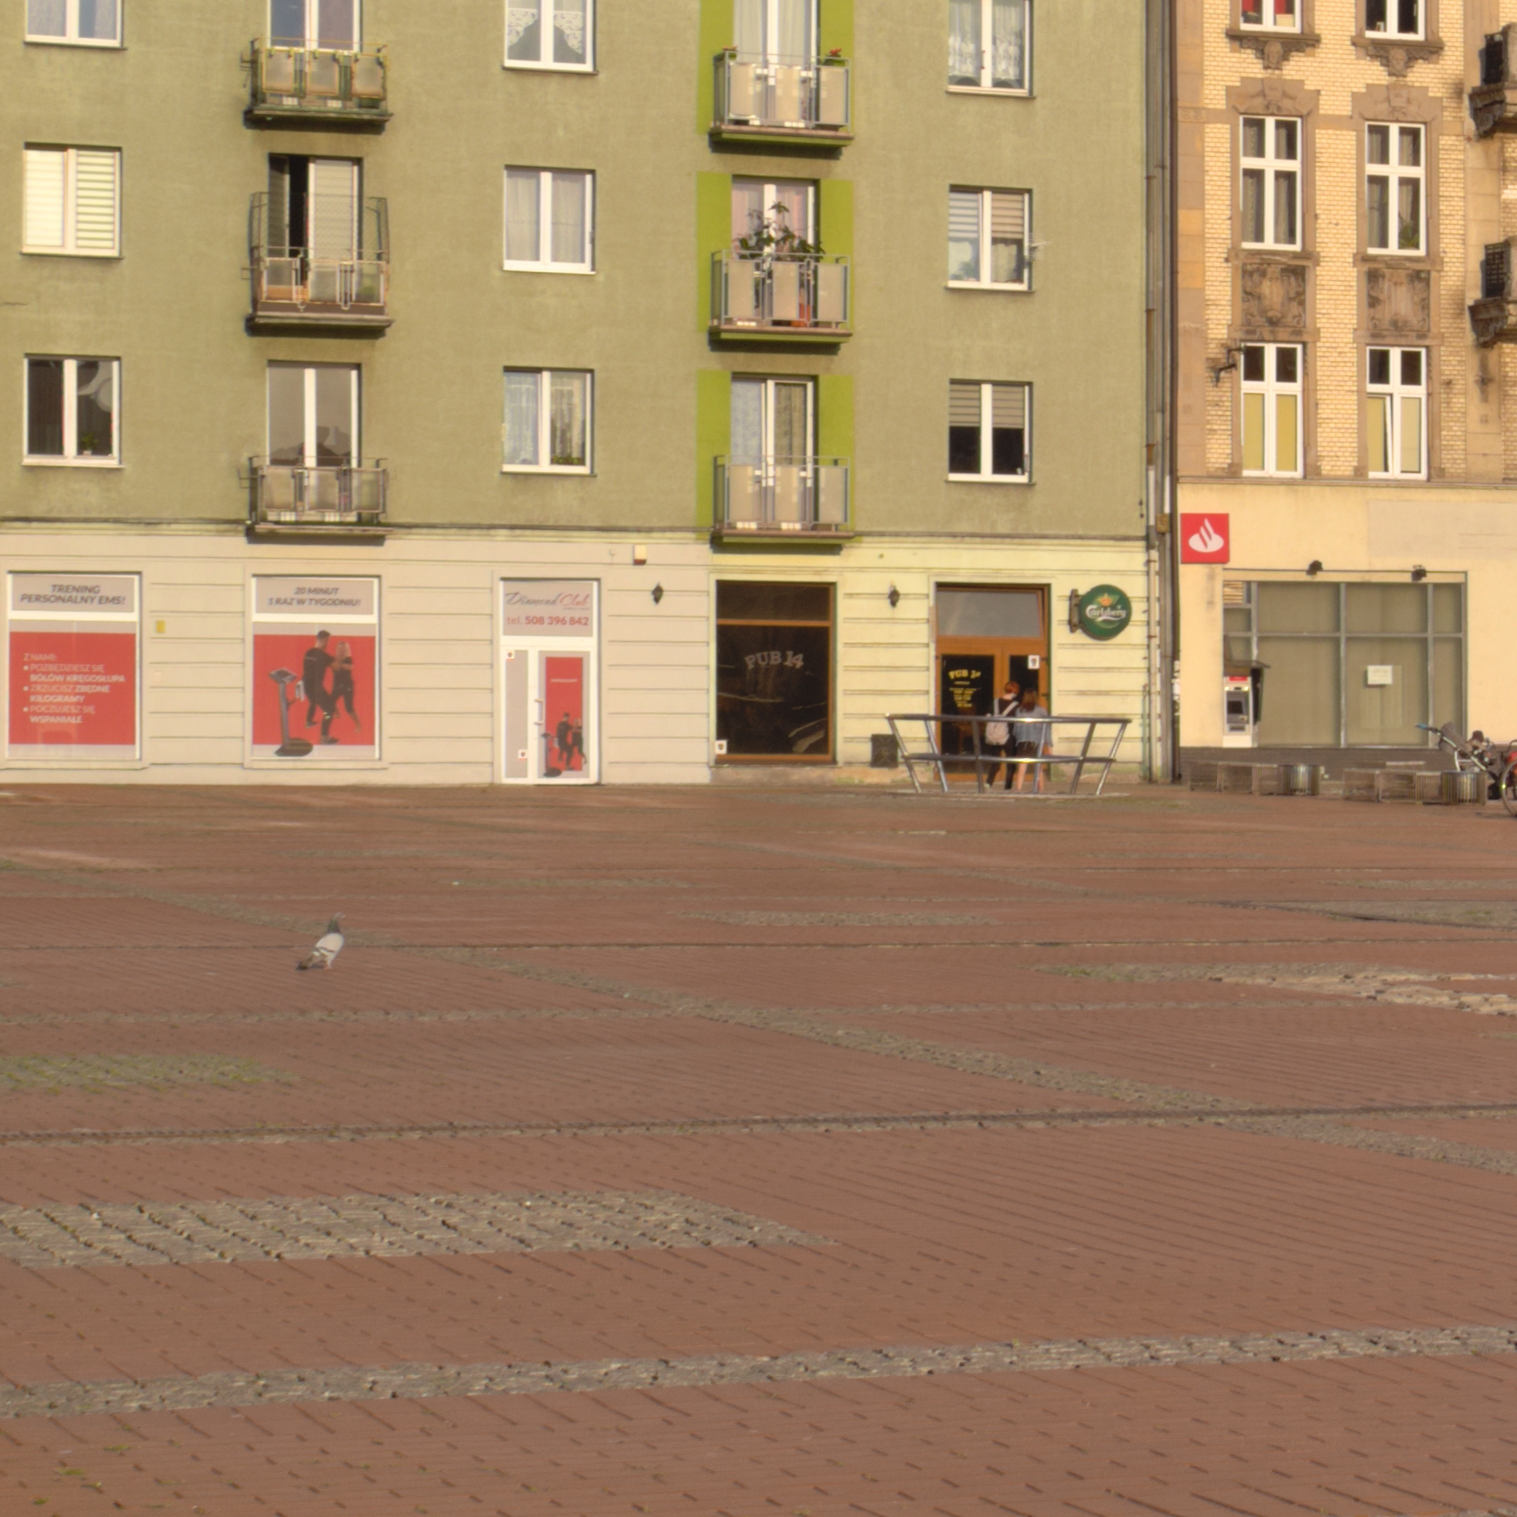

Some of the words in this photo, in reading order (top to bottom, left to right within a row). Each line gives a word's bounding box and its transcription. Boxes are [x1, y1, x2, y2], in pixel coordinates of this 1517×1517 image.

[51, 584, 101, 594] TRENING
[294, 587, 306, 595] 20
[307, 587, 339, 595] MINUT
[20, 593, 96, 604] PERSONALNY
[98, 595, 126, 605] EMS!
[274, 598, 295, 606] RAZ
[296, 598, 307, 606] W
[560, 593, 590, 607] Club
[525, 616, 545, 625] 508
[546, 616, 567, 626] 396
[569, 616, 589, 626] 842
[744, 651, 782, 669] PUB
[783, 651, 804, 668] 14
[30, 694, 85, 703] KILOGRAMY
